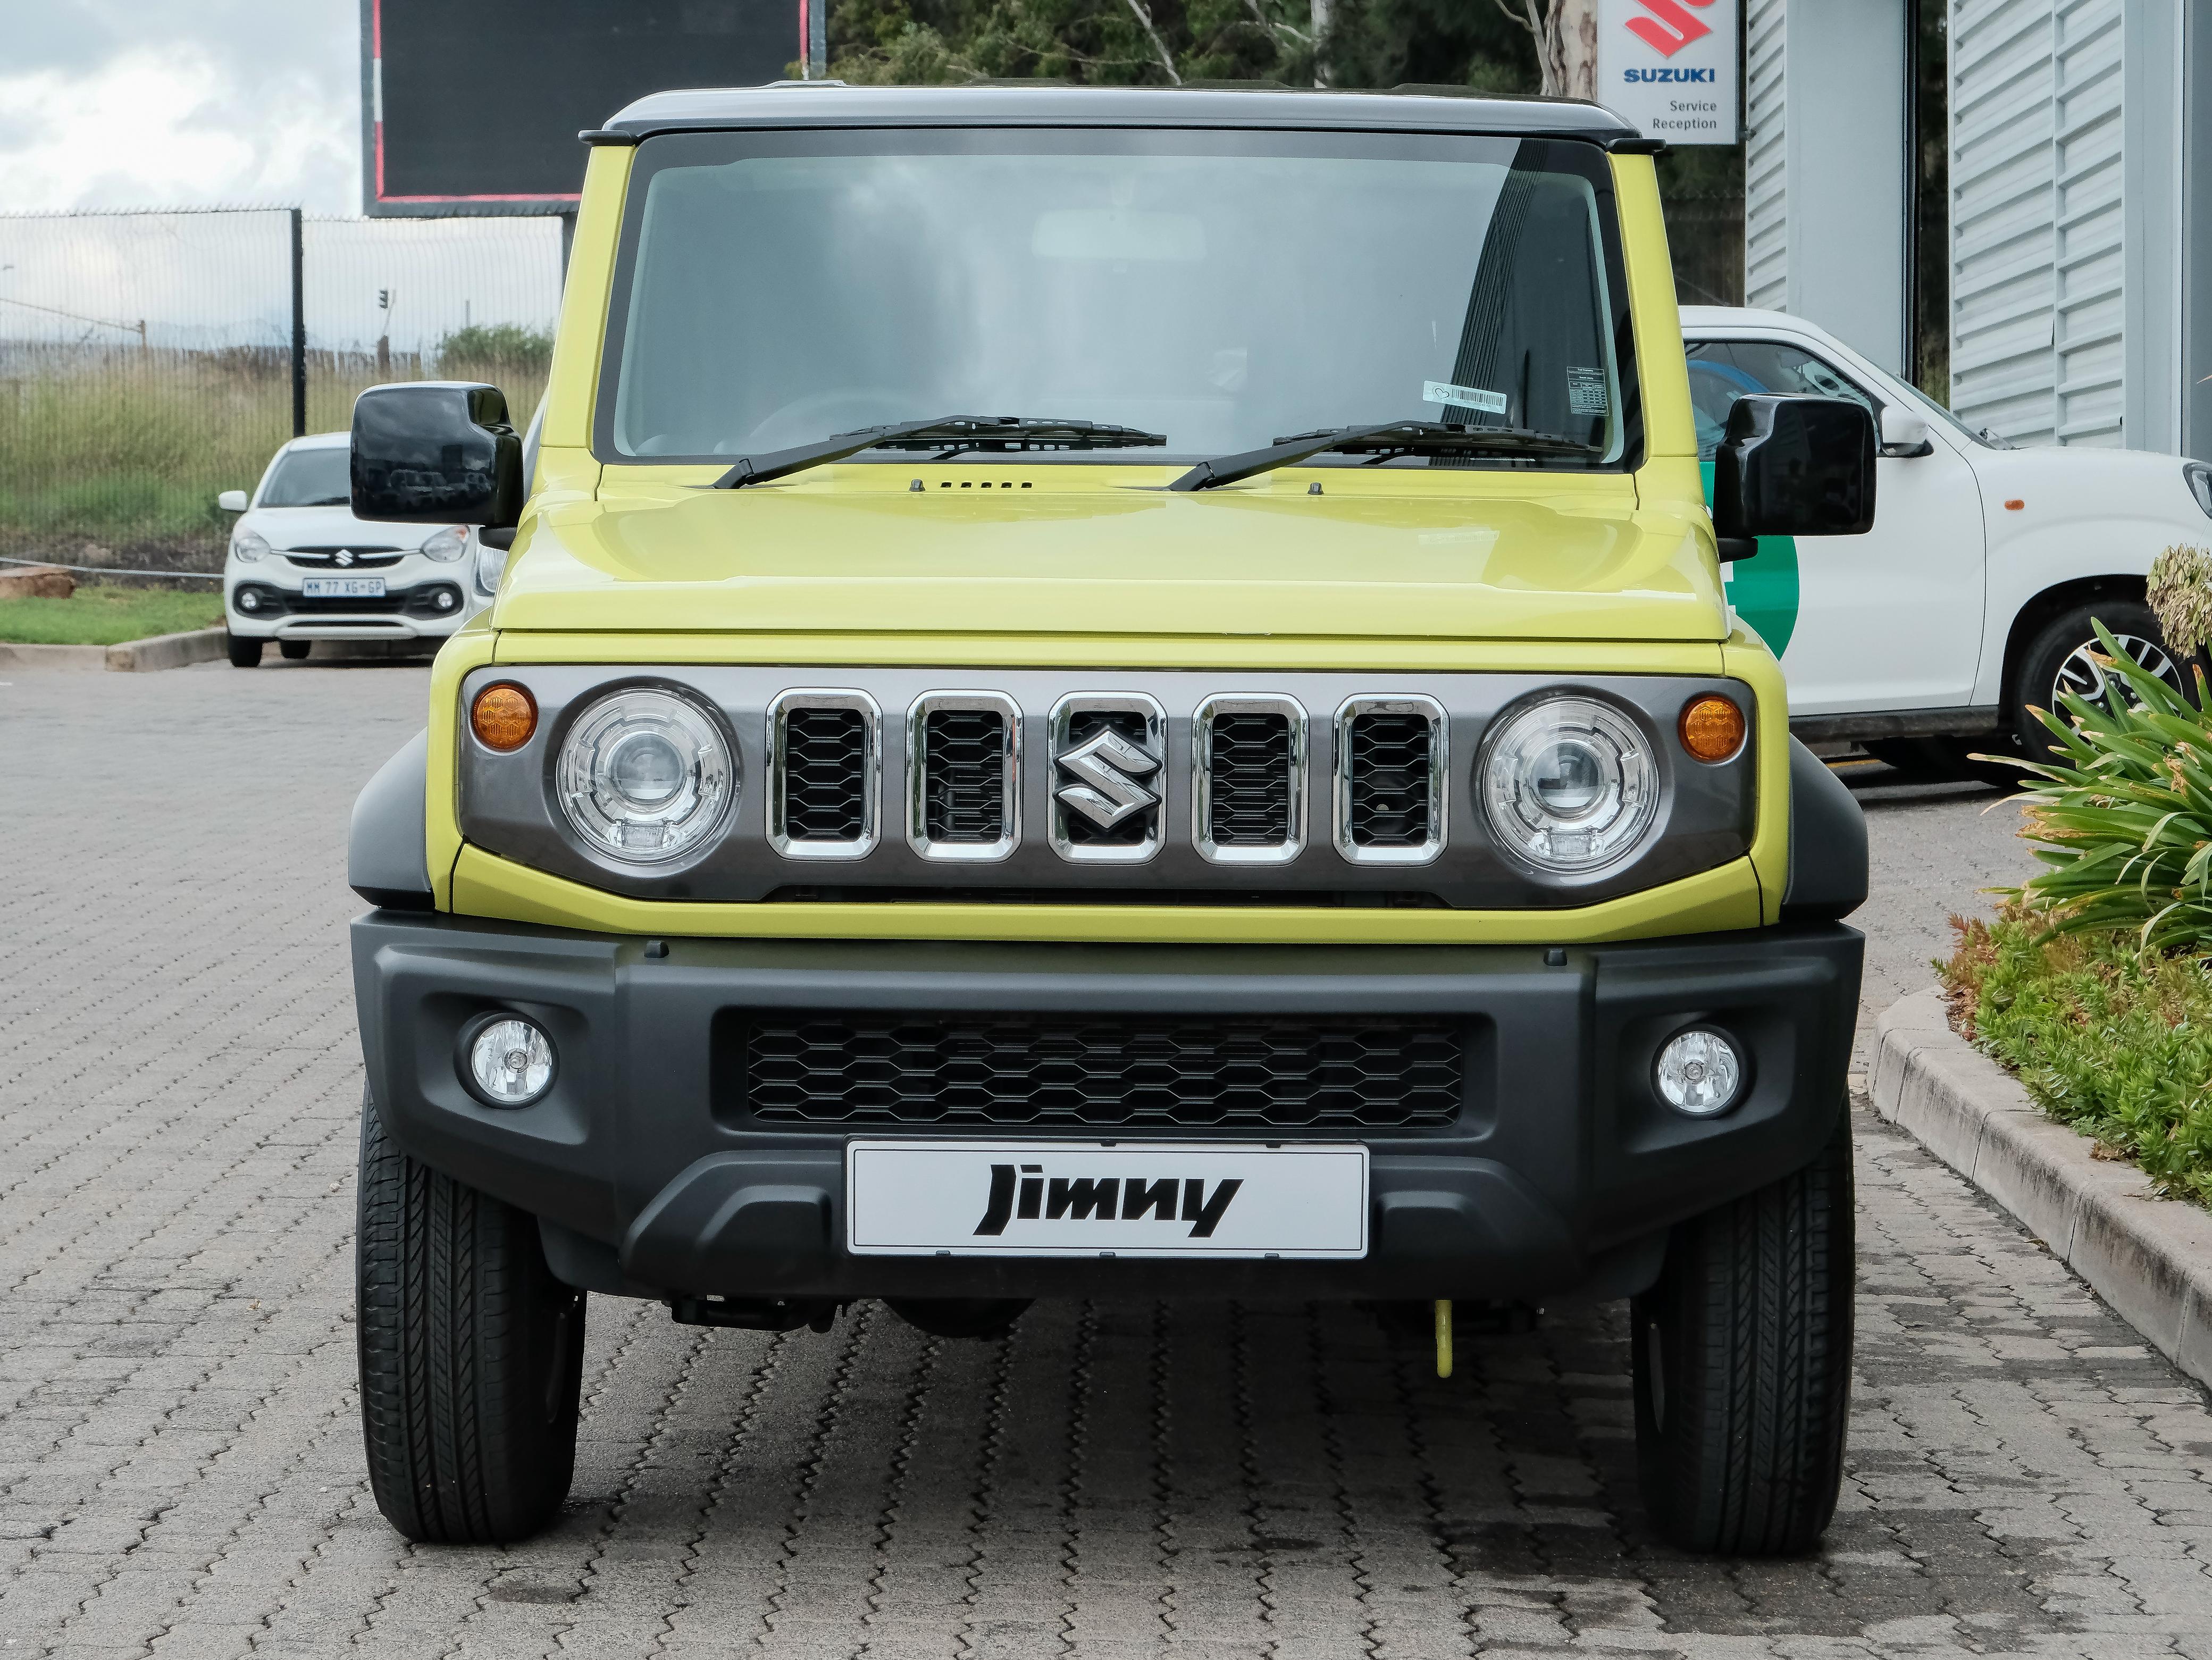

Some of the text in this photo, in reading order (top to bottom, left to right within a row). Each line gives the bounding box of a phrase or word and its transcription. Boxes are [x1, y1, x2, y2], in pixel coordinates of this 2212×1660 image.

[1623, 68, 1716, 83] SUZUKI
[1670, 99, 1717, 112] Service
[1653, 117, 1717, 132] Reception
[325, 581, 339, 593] 77
